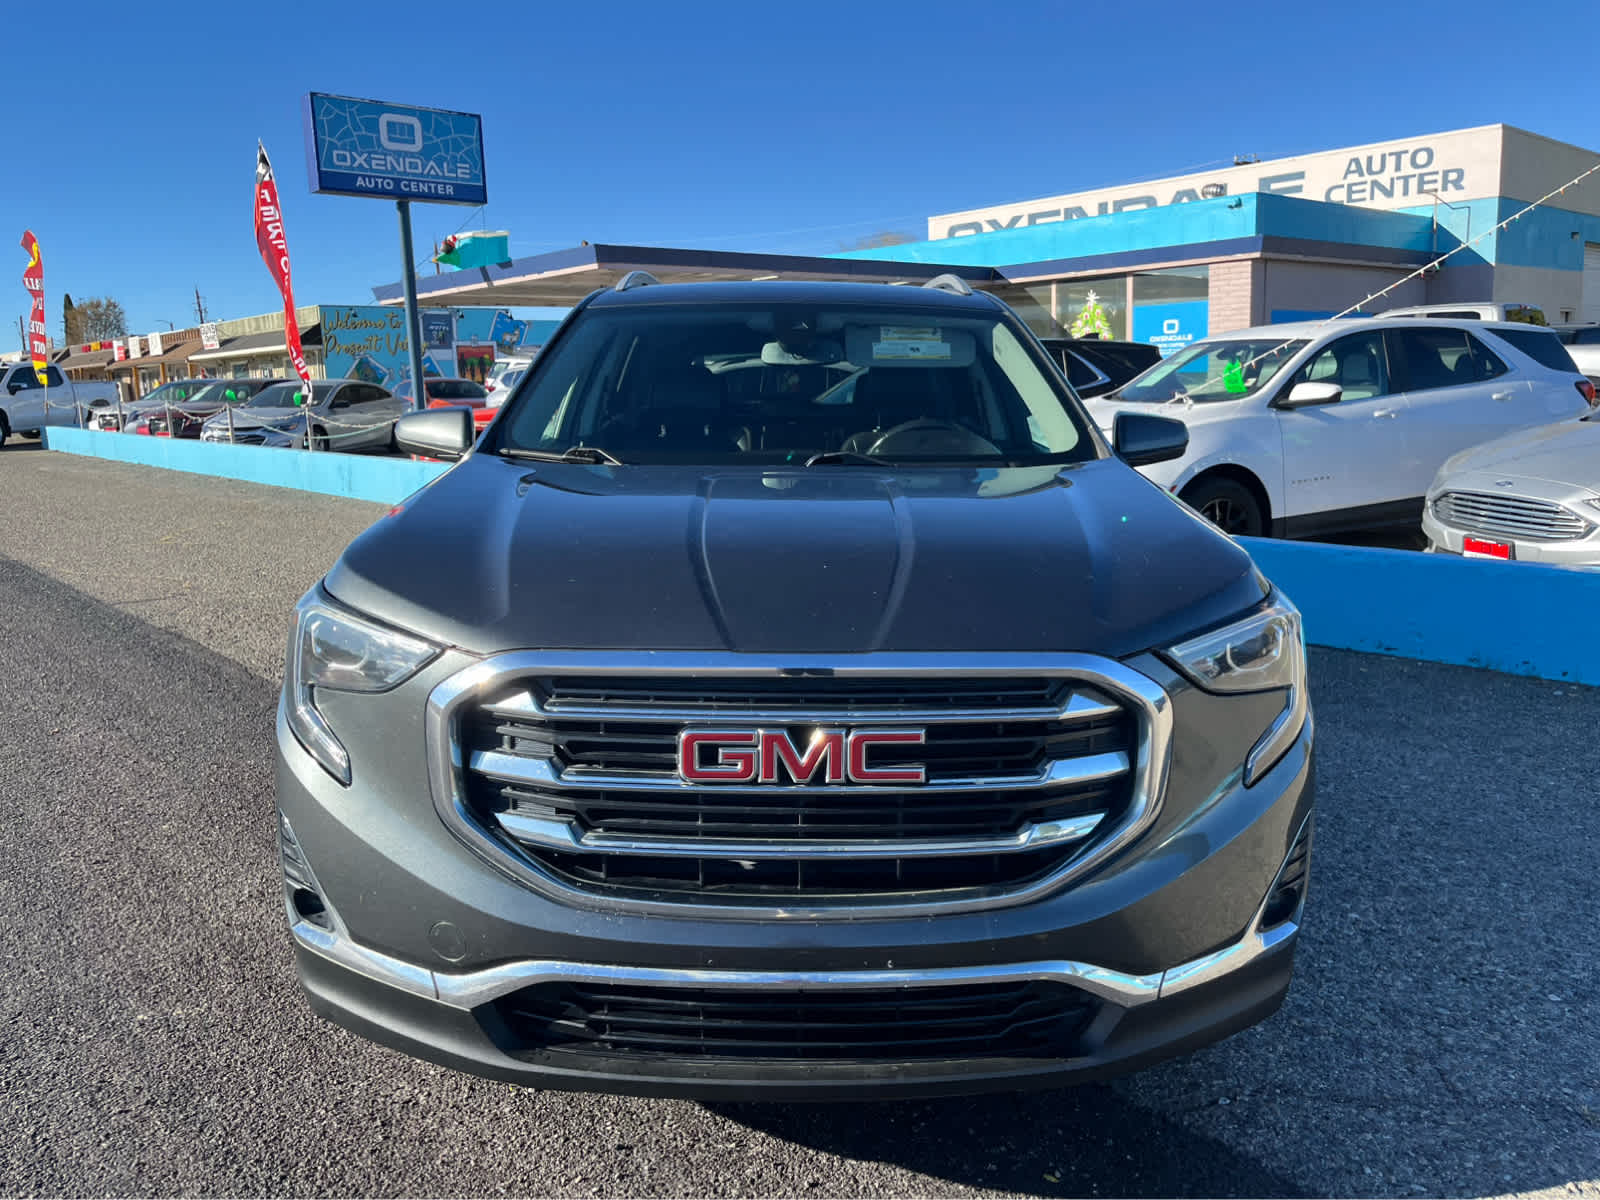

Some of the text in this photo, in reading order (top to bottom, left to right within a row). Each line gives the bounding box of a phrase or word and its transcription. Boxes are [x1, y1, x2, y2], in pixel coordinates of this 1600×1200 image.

[332, 149, 471, 179] OXENDALE
[1342, 146, 1435, 180] AUTO
[355, 175, 455, 195] AUTO CENTER
[1324, 167, 1465, 204] CENTER
[947, 171, 1306, 239] OXENDAE
[320, 310, 404, 335] Welcome to
[385, 332, 429, 357] Vay
[677, 727, 927, 784] GMC
